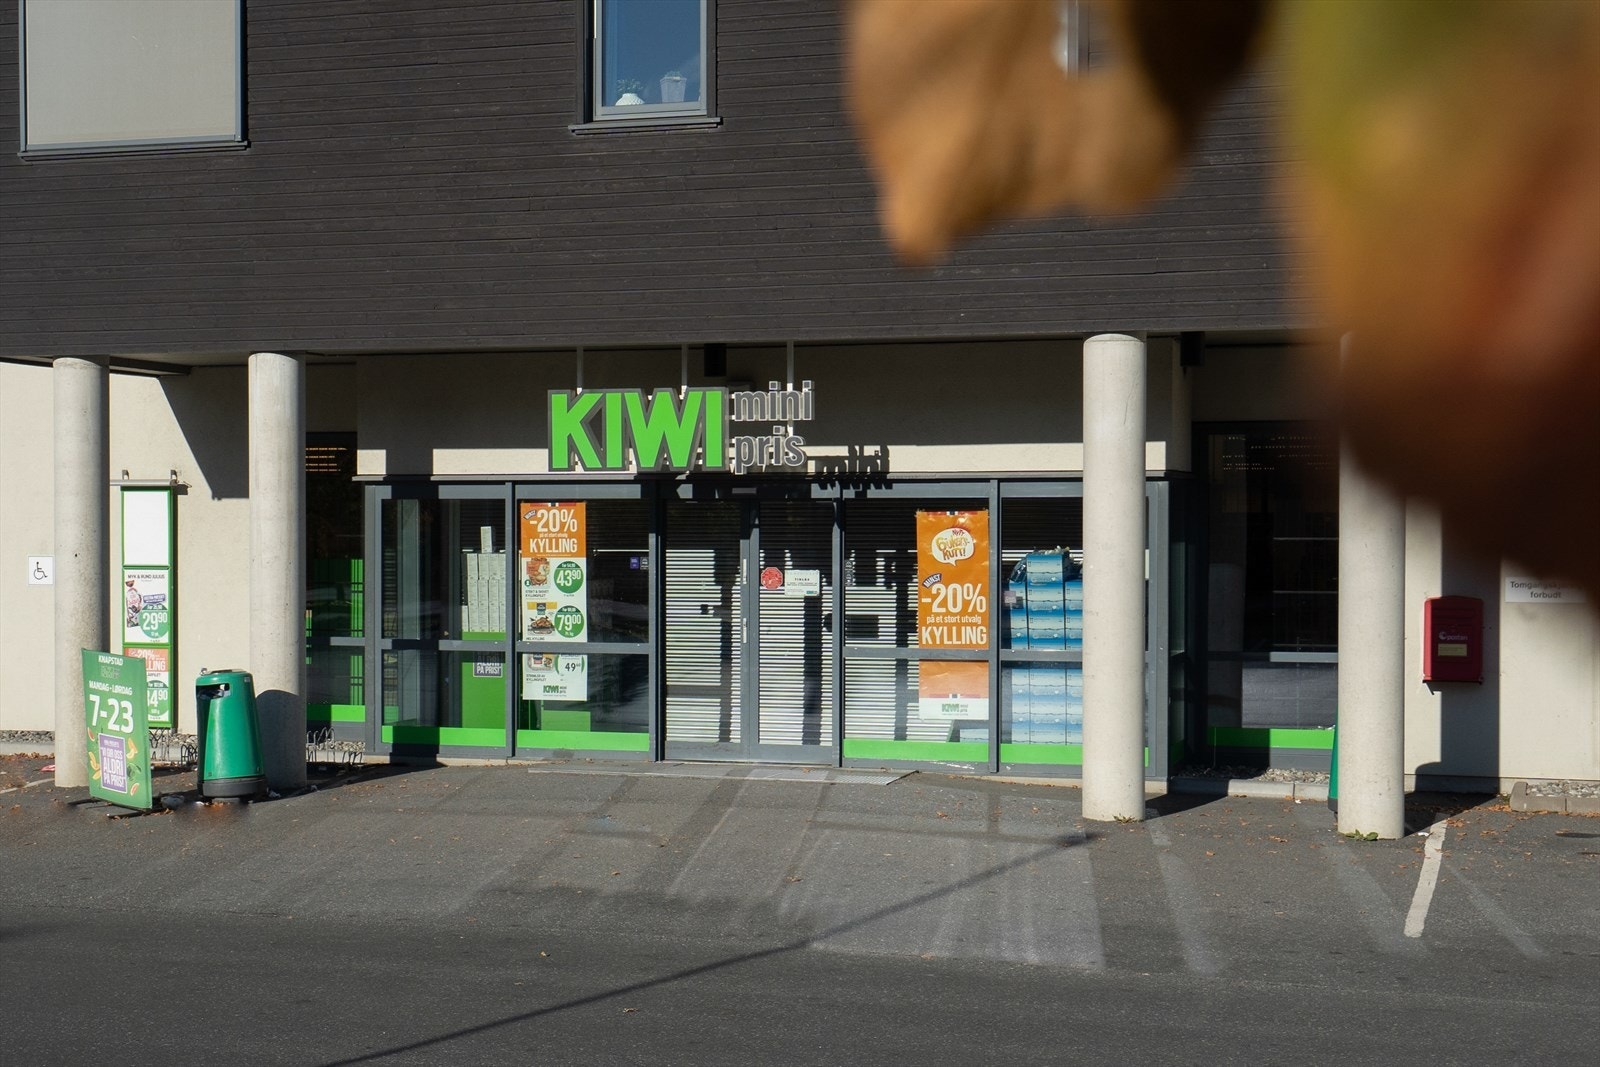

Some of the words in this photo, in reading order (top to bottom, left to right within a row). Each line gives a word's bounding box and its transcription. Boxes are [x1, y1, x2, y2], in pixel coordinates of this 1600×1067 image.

[734, 380, 814, 421] mini
[549, 388, 726, 471] KIWI
[734, 426, 805, 475] pris
[529, 509, 578, 532] -20%
[530, 538, 578, 553] KYLLING
[921, 583, 986, 613] -20%
[926, 614, 935, 624] på
[936, 614, 943, 623] et
[944, 614, 960, 623] stort
[961, 614, 982, 624] utvalg
[921, 626, 986, 644] KYLLING
[98, 655, 123, 666] KNAPSTAD
[89, 694, 134, 734] 7-23
[103, 756, 124, 776] ALDRI
